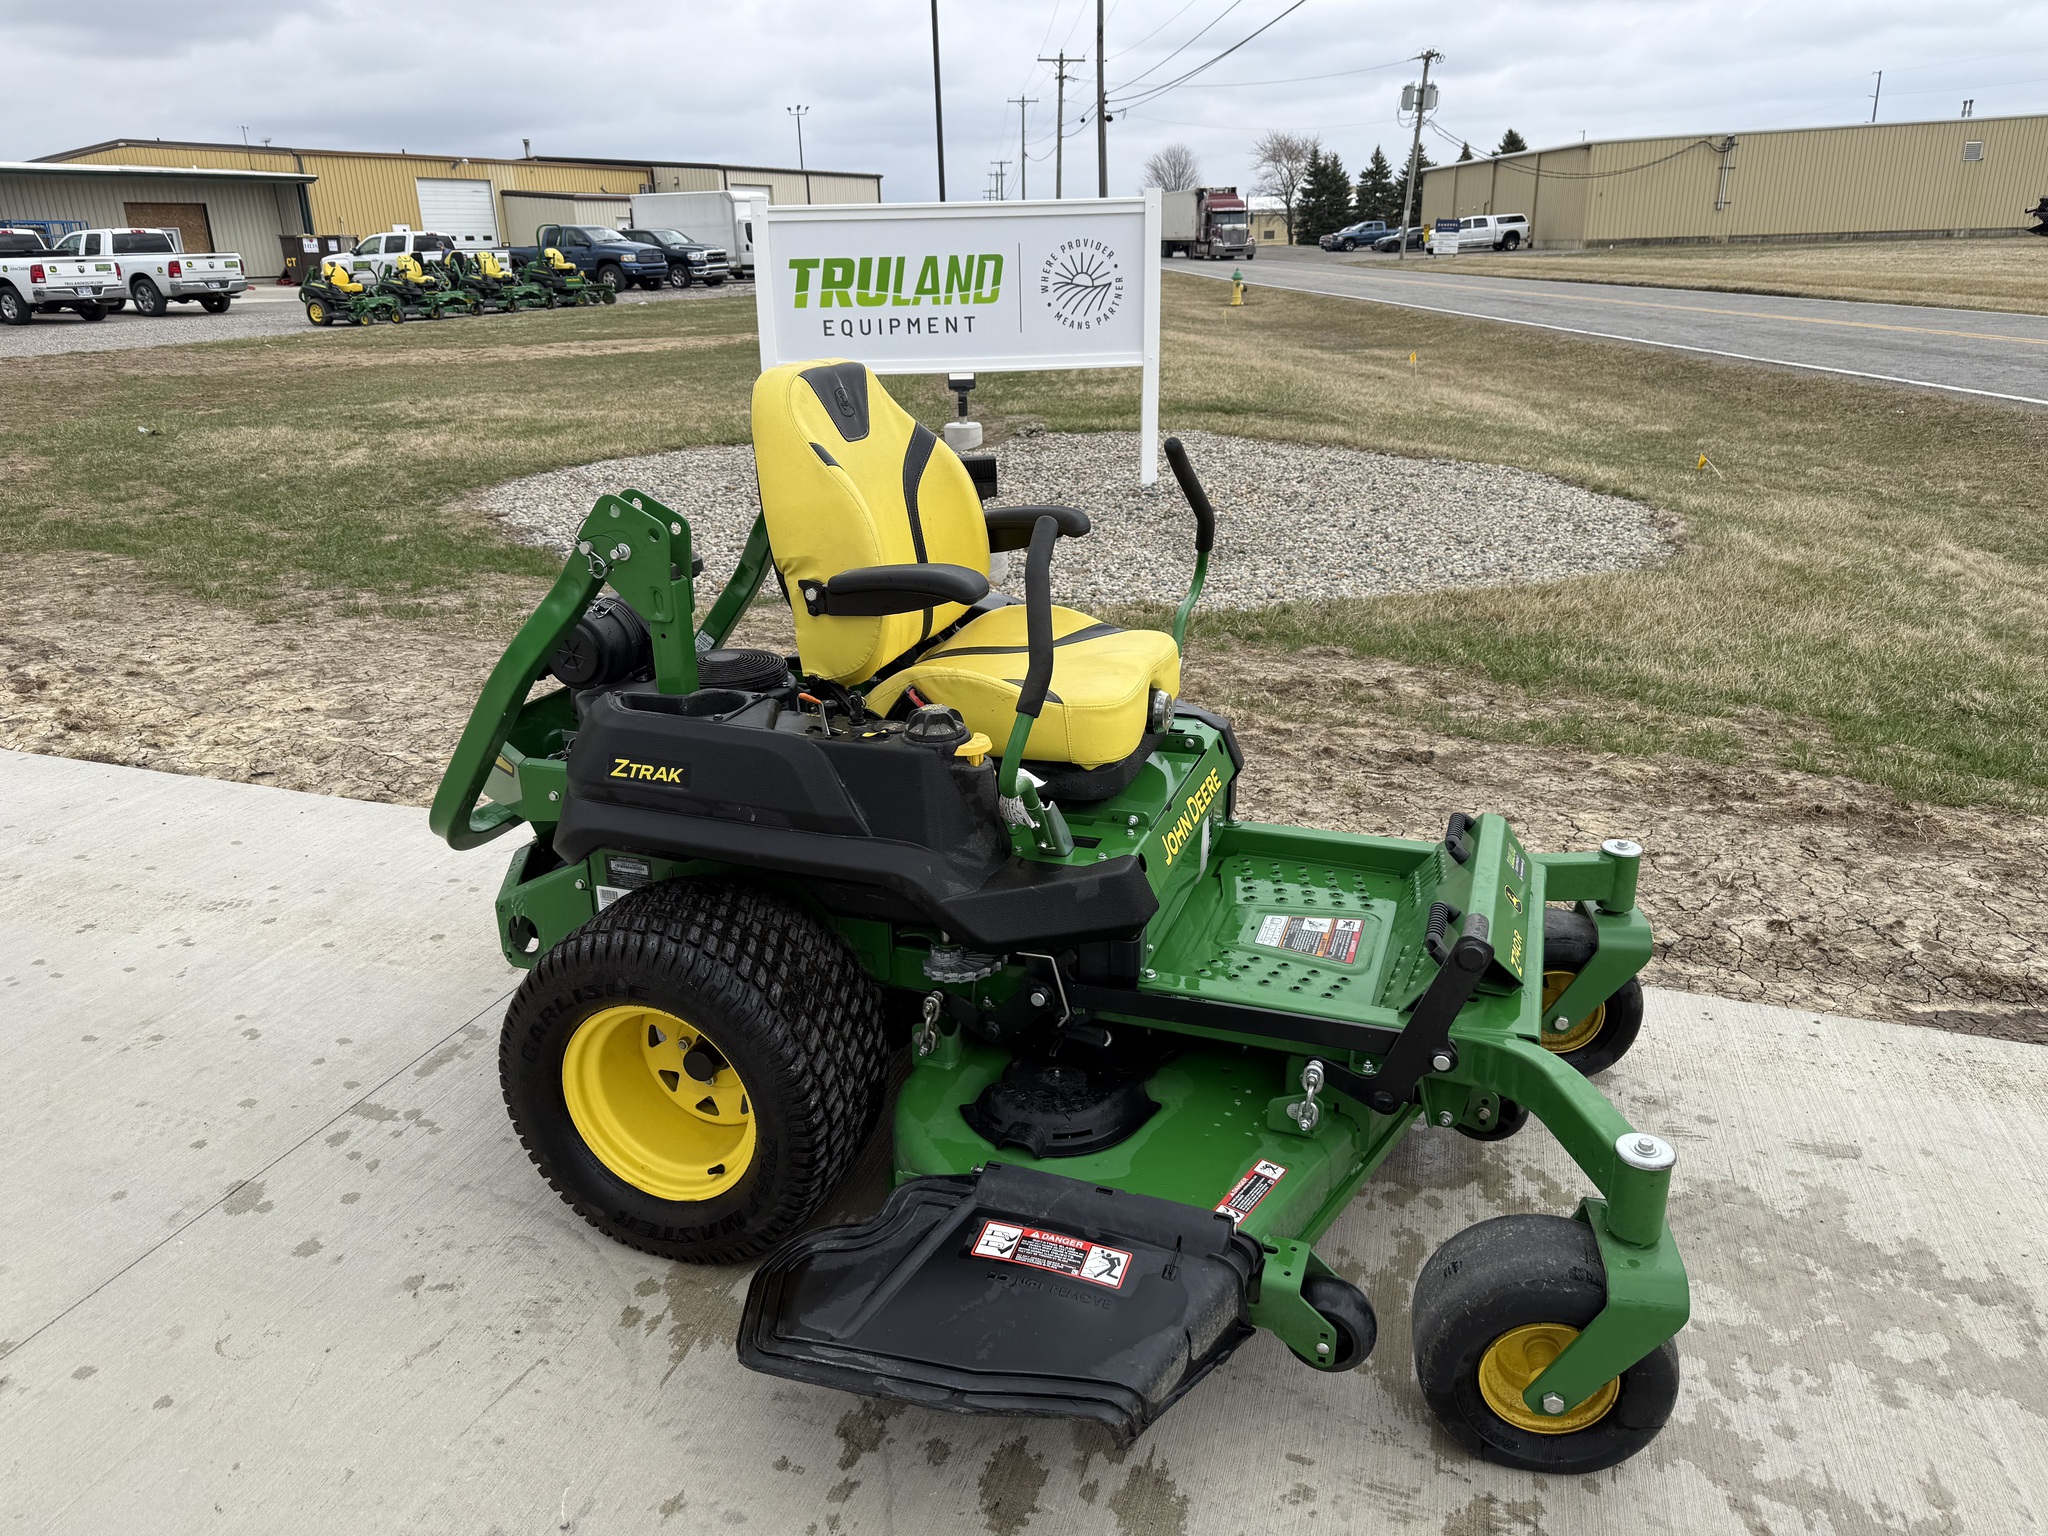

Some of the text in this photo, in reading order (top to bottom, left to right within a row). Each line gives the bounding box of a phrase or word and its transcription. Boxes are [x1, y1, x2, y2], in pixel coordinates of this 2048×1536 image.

[286, 257, 297, 267] CT
[789, 254, 1004, 308] TRULAND
[1041, 238, 1115, 294] WHERE PROVIDER
[823, 316, 976, 337] EQUIPMENT
[1054, 277, 1124, 330] MEANS PARTNER
[1161, 766, 1223, 867] JOHN DEERE
[521, 982, 650, 1065] CARLISLE
[612, 1208, 748, 1244] MASTER
[1041, 1233, 1084, 1248] DANGER
